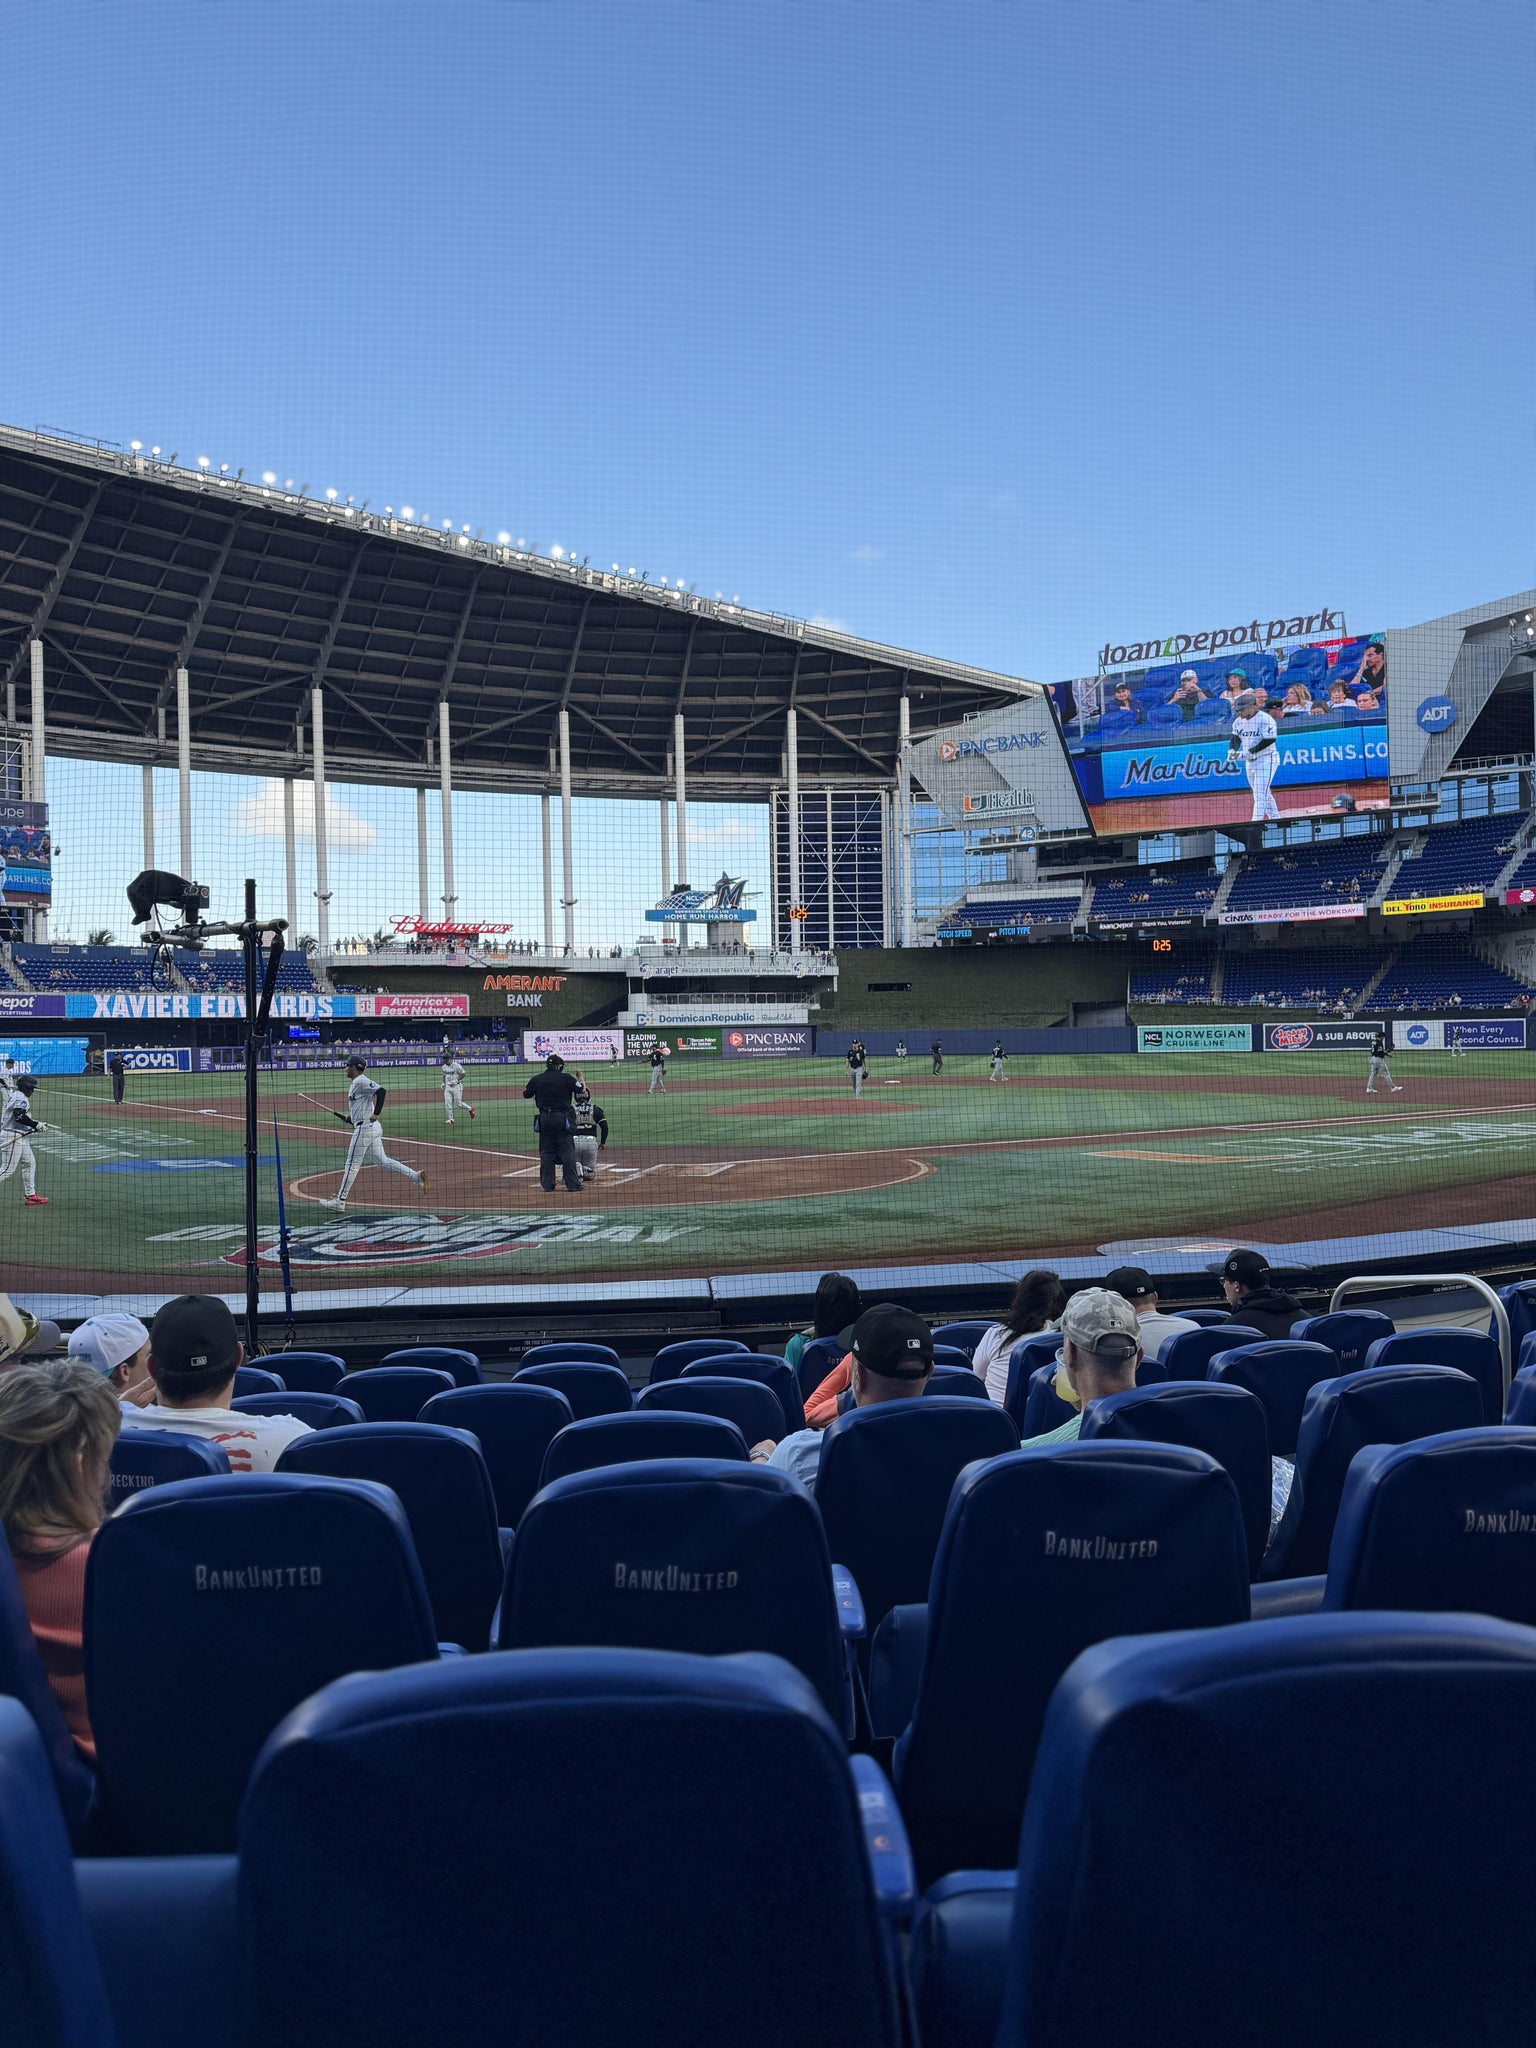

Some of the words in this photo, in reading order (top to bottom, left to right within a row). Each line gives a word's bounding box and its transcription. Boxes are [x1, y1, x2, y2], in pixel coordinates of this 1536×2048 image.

[1103, 619, 1259, 666] loanDepot
[1266, 608, 1337, 646] park
[1421, 706, 1451, 722] ADT
[1120, 753, 1241, 788] Marlins
[1021, 829, 1034, 839] 42
[7, 874, 51, 885] ARLINS.CO
[685, 894, 700, 902] NCL
[1386, 905, 1401, 913] DEL
[1429, 899, 1480, 909] INSURANCE
[789, 908, 807, 920] 0:25
[1258, 912, 1281, 920] READY
[1285, 911, 1297, 919] FOR
[1302, 910, 1316, 918] THE
[937, 930, 953, 938] PITCH
[955, 929, 972, 937] SPEED
[999, 927, 1015, 935] PITCH
[1017, 926, 1031, 934] TYPE
[1153, 940, 1172, 951] 0:25
[655, 966, 678, 978] arajet
[807, 965, 827, 978] arajet
[483, 975, 562, 991] AMERANT
[391, 996, 453, 1006] America's
[507, 994, 543, 1007] BANK
[93, 995, 189, 1018] XAVIER
[381, 1006, 410, 1016] Best
[411, 1006, 463, 1016] Network
[1166, 1030, 1246, 1039] NORWEGIAN
[1276, 1027, 1308, 1039] Jersey
[1325, 1032, 1344, 1040] SUB
[1346, 1031, 1377, 1040] ABOVE
[1410, 1031, 1426, 1039] ADT
[1480, 1026, 1504, 1036] Every
[1145, 1033, 1161, 1041] NCL
[1456, 1036, 1487, 1044] econd
[1488, 1035, 1523, 1043] Counts.
[627, 1048, 640, 1056] EYE
[123, 1053, 175, 1069] GOYA
[514, 1225, 705, 1243] DAY
